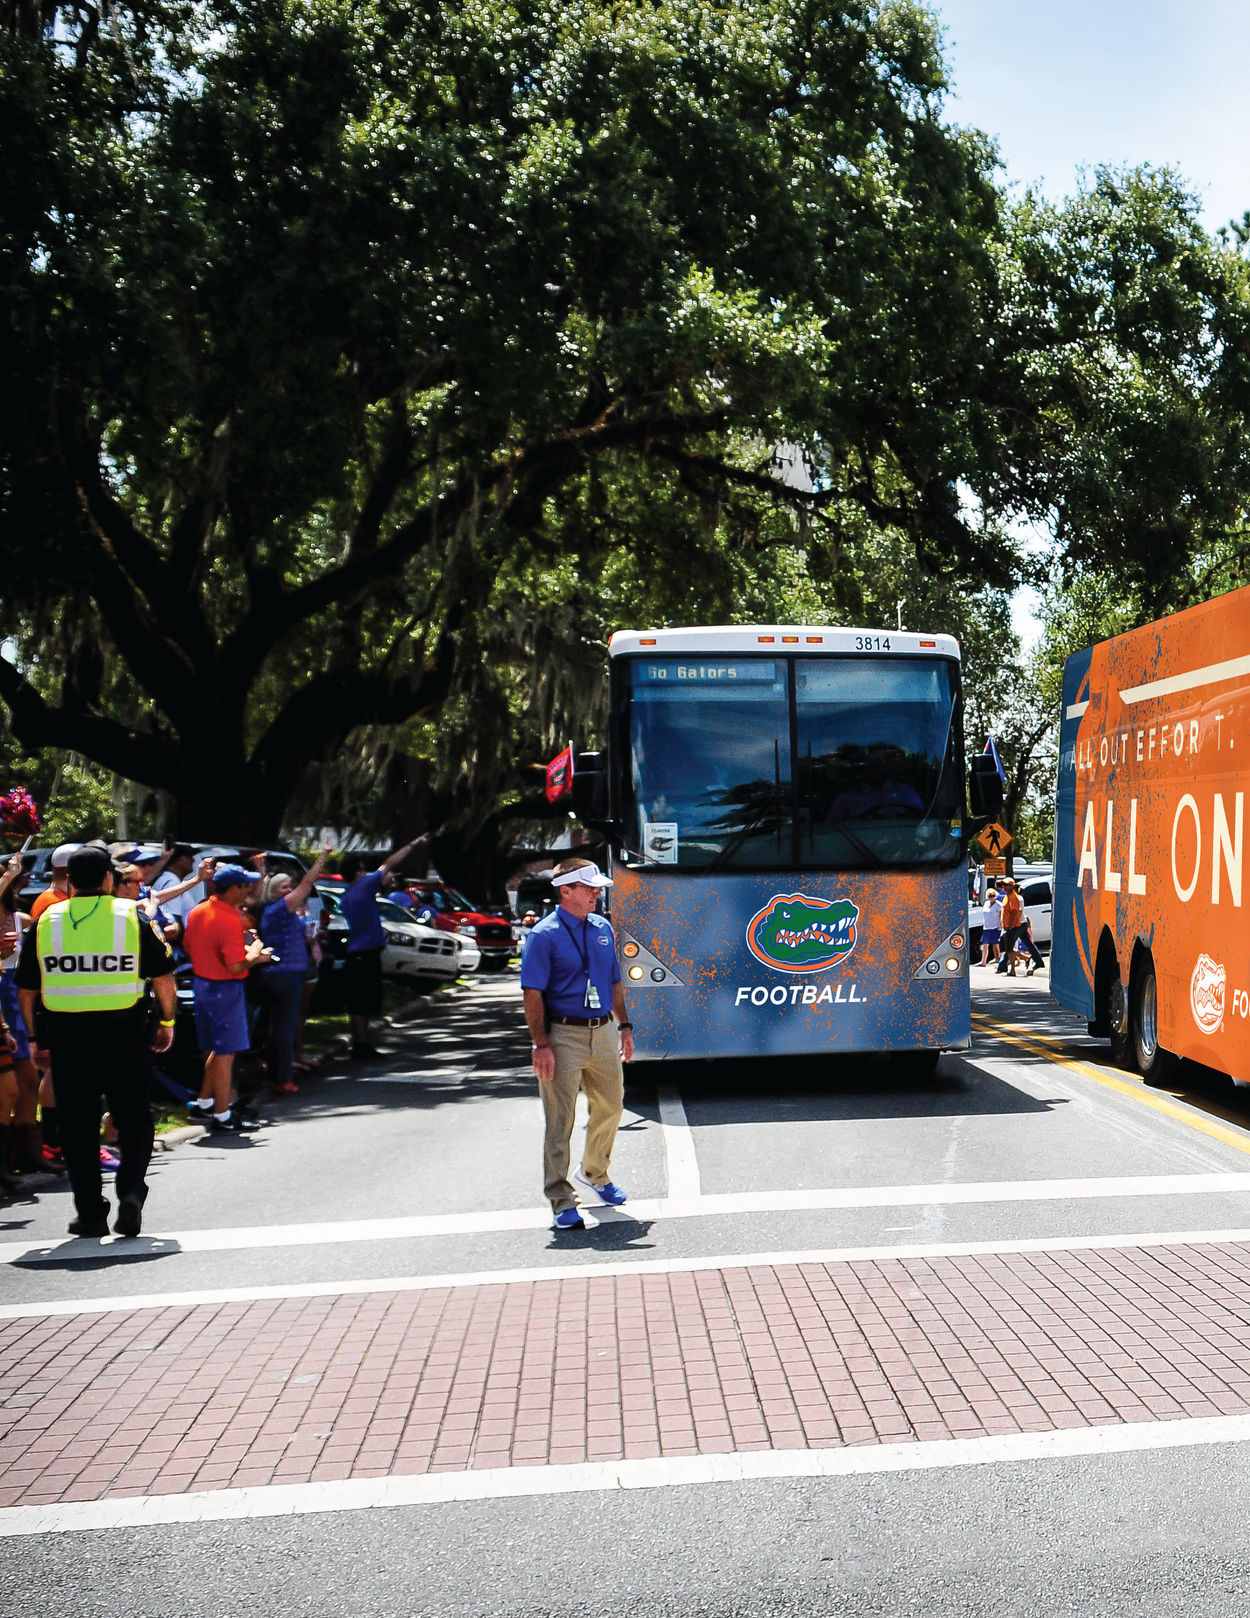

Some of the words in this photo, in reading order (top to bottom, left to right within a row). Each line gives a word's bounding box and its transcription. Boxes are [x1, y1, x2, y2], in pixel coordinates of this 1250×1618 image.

[855, 636, 891, 651] 3814
[677, 666, 737, 679] Gators
[1070, 741, 1092, 771] ALL
[1101, 734, 1128, 767] OUT
[1077, 799, 1147, 895] ALL
[1171, 792, 1244, 908] ON
[44, 955, 134, 972] POLICE
[735, 984, 867, 1006] FOOTBALL.
